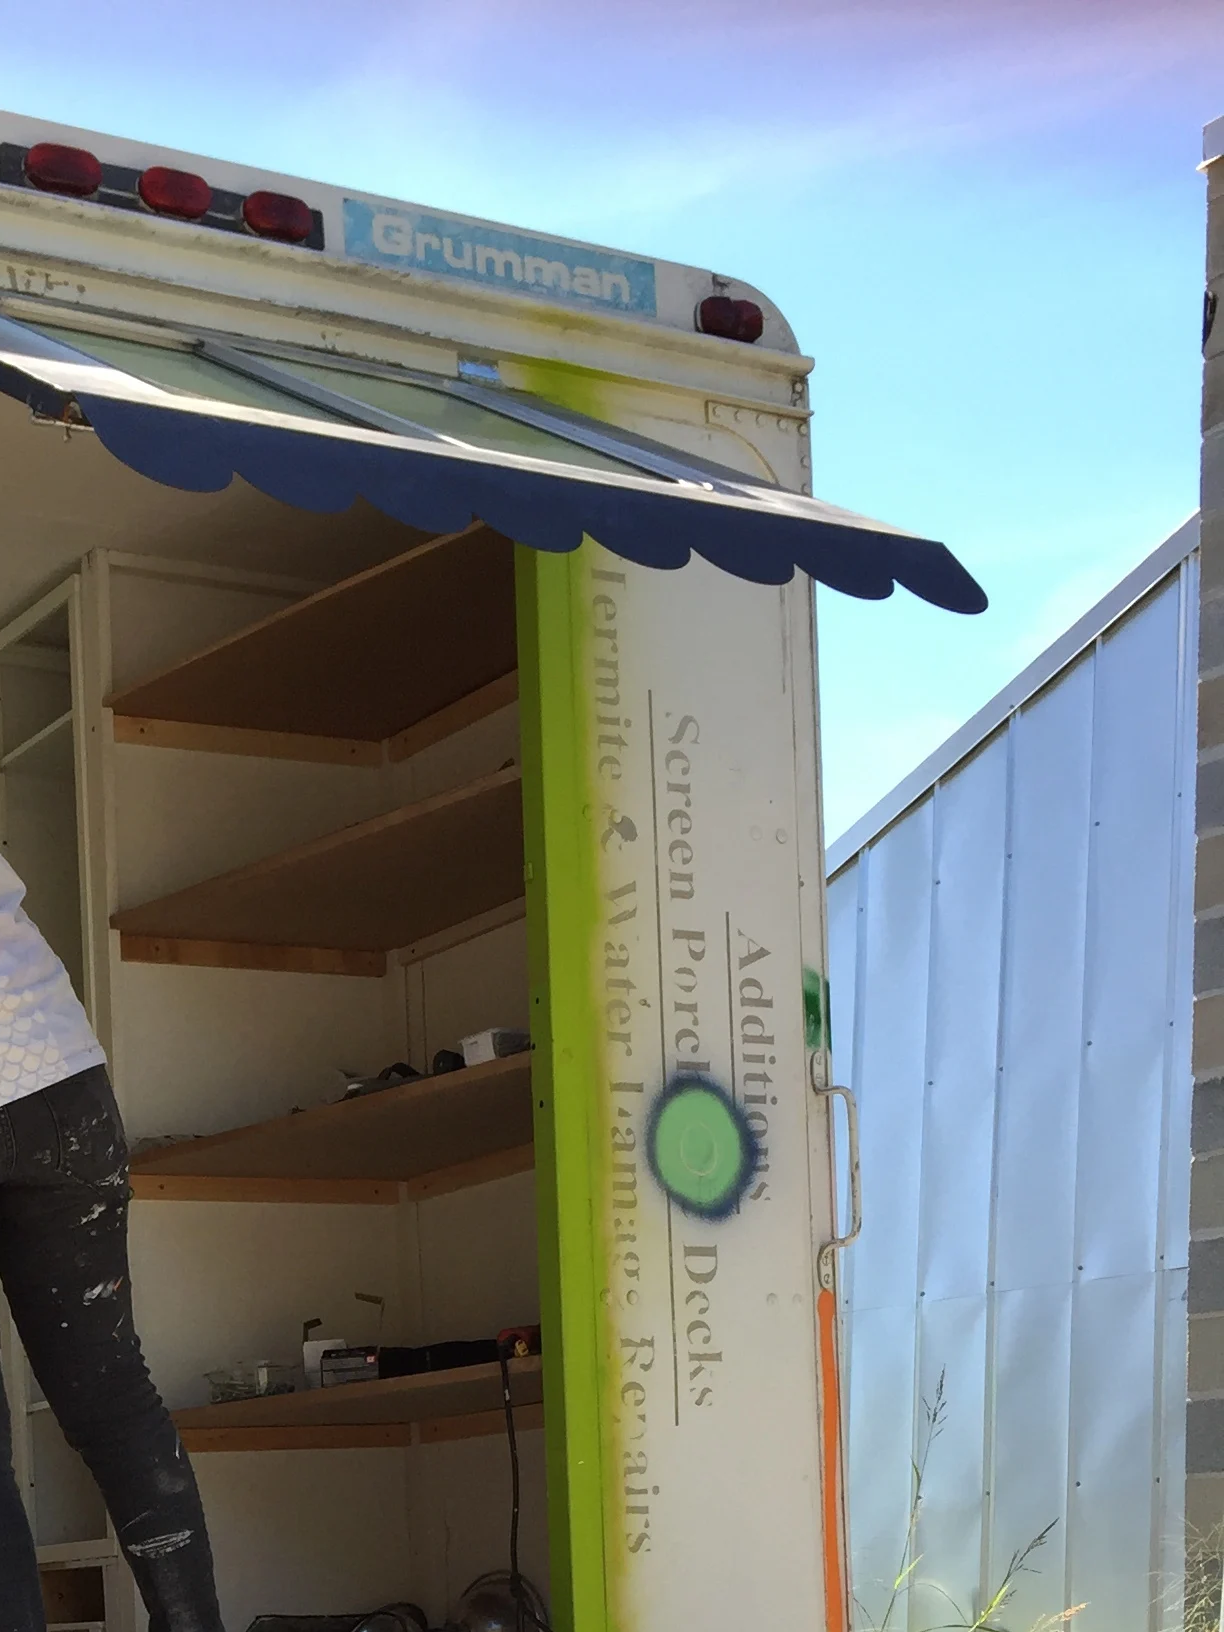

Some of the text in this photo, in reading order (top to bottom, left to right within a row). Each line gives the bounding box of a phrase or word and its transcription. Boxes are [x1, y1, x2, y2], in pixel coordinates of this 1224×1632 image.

[372, 212, 631, 305] Grumman
[590, 566, 633, 782] Termite
[603, 880, 638, 1058] Water
[664, 713, 700, 902] Screen
[682, 1243, 723, 1407] Decks
